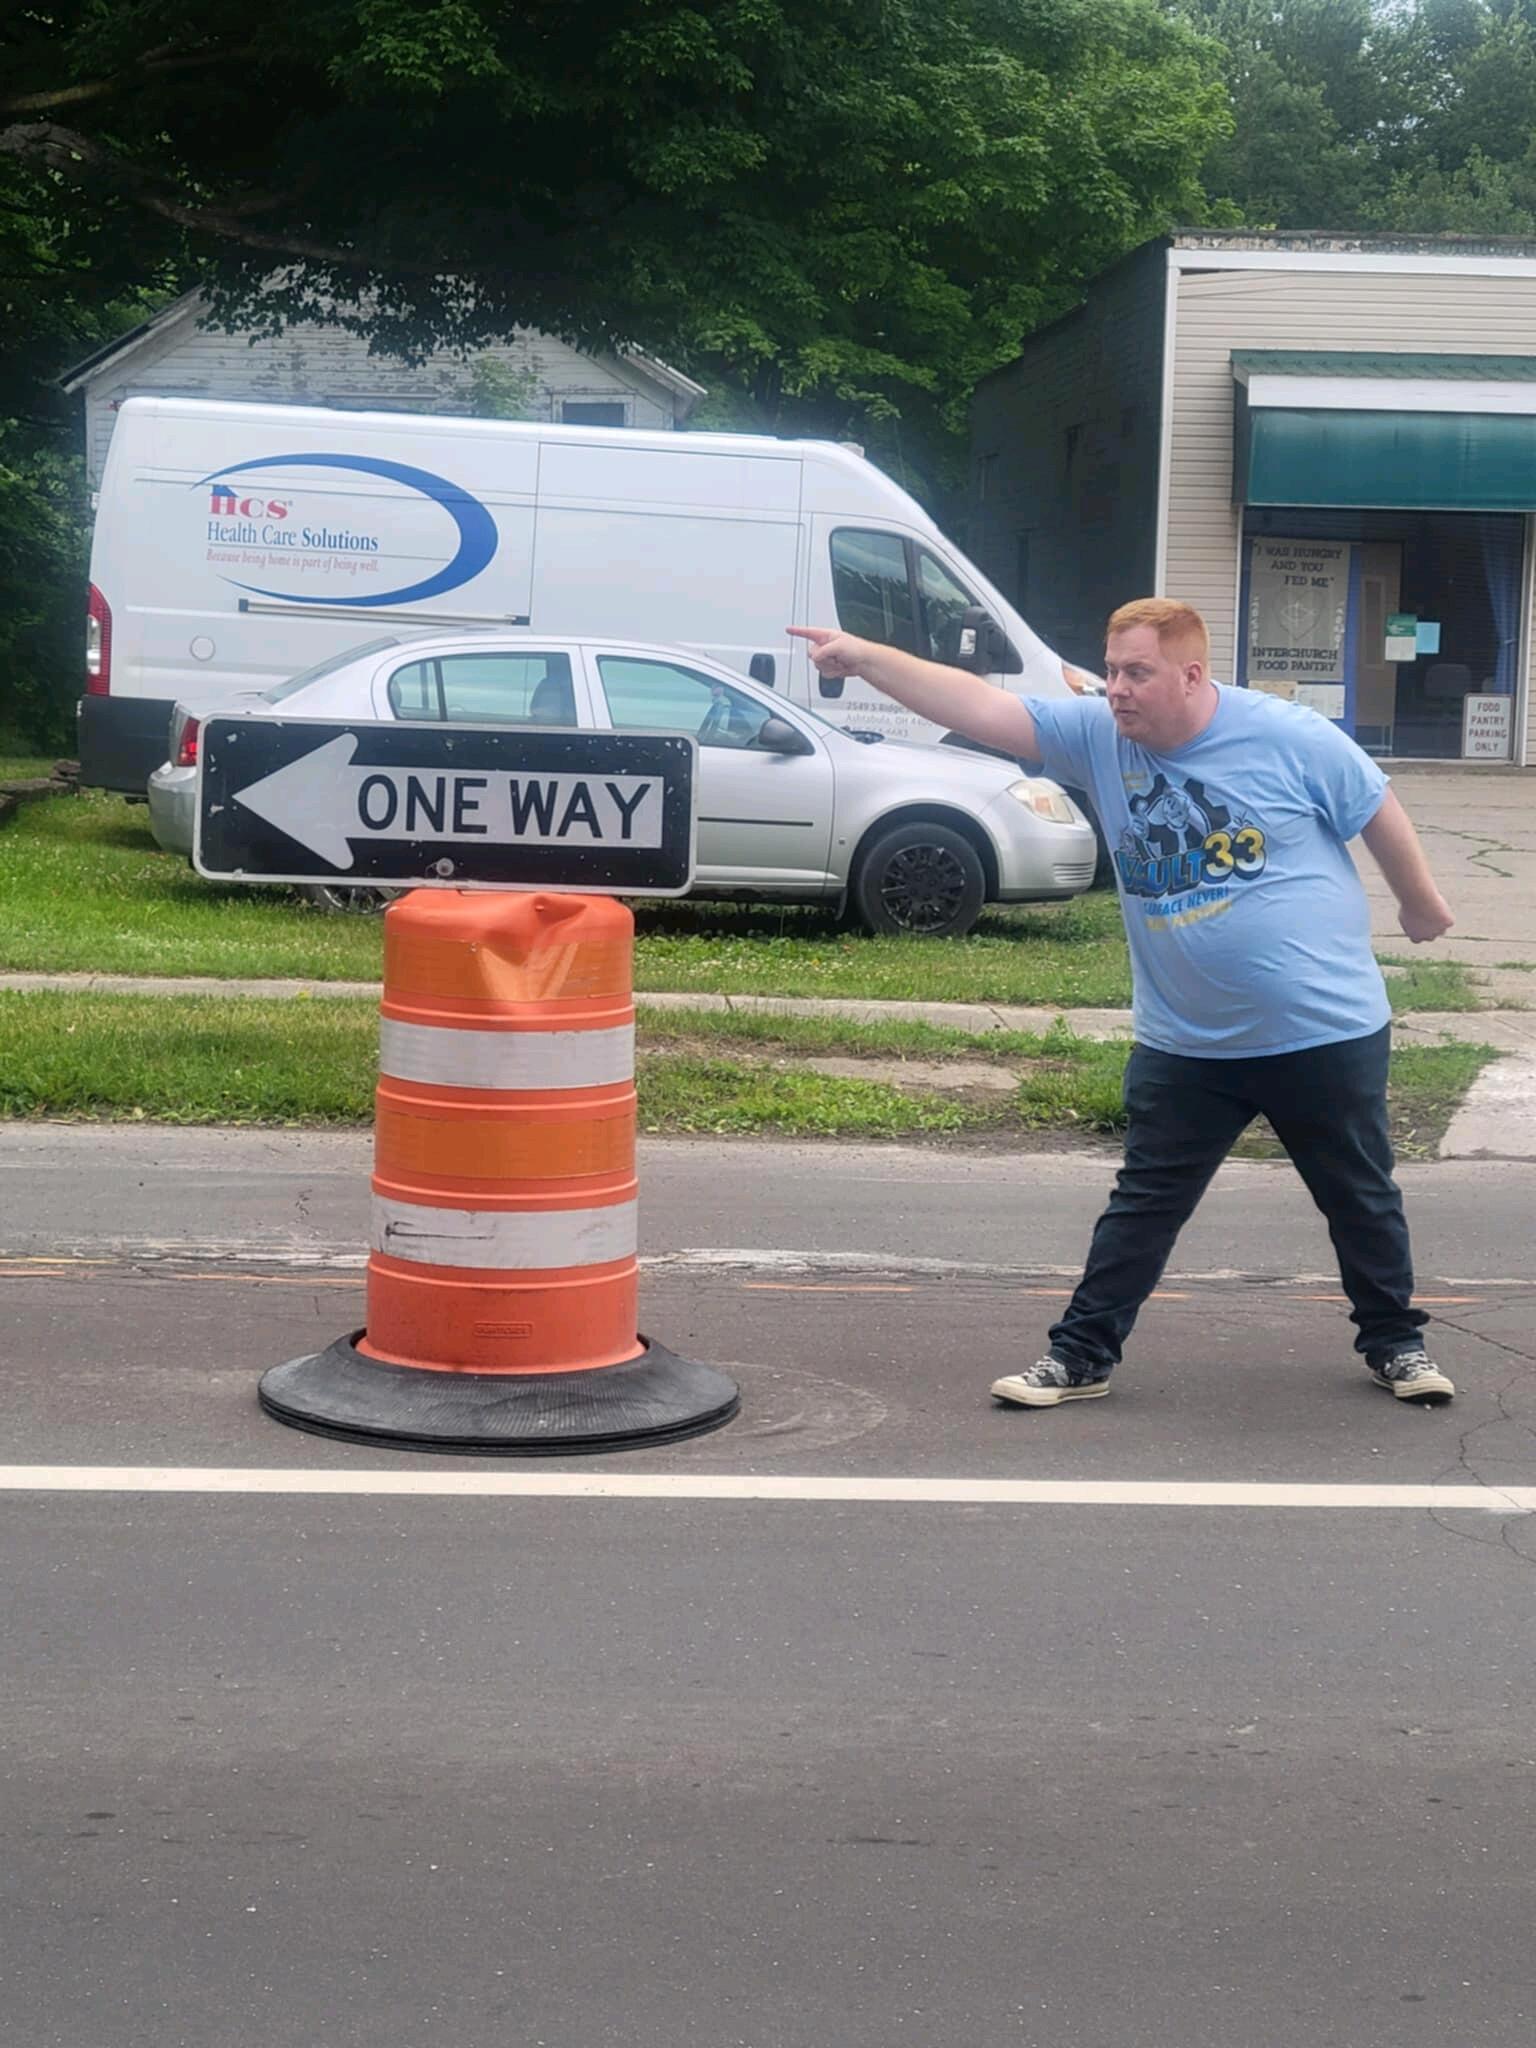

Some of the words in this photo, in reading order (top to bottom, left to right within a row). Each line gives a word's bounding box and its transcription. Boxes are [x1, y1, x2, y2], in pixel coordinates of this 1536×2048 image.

[208, 521, 257, 544] Health
[262, 524, 297, 546] Care
[302, 527, 378, 551] Solutions
[1293, 548, 1343, 560] HUNGRY
[206, 548, 240, 562] Because
[242, 551, 266, 569] being
[269, 553, 291, 566] home
[292, 555, 300, 566] is
[301, 557, 321, 573] part
[322, 556, 333, 574] of
[333, 557, 357, 576] being
[1271, 560, 1297, 571] AND
[1301, 562, 1324, 573] YOU
[1284, 575, 1307, 587] FED
[1252, 647, 1338, 660] INTERCHURCH
[1256, 660, 1289, 671] FOOD
[1291, 661, 1337, 672] PANTRY
[1477, 703, 1500, 712] FOOD
[1471, 715, 1505, 726] PANTRY
[1469, 728, 1507, 739] PARKING
[1475, 743, 1498, 752] ONLY
[357, 773, 488, 835] ONE
[509, 778, 652, 840] WAY
